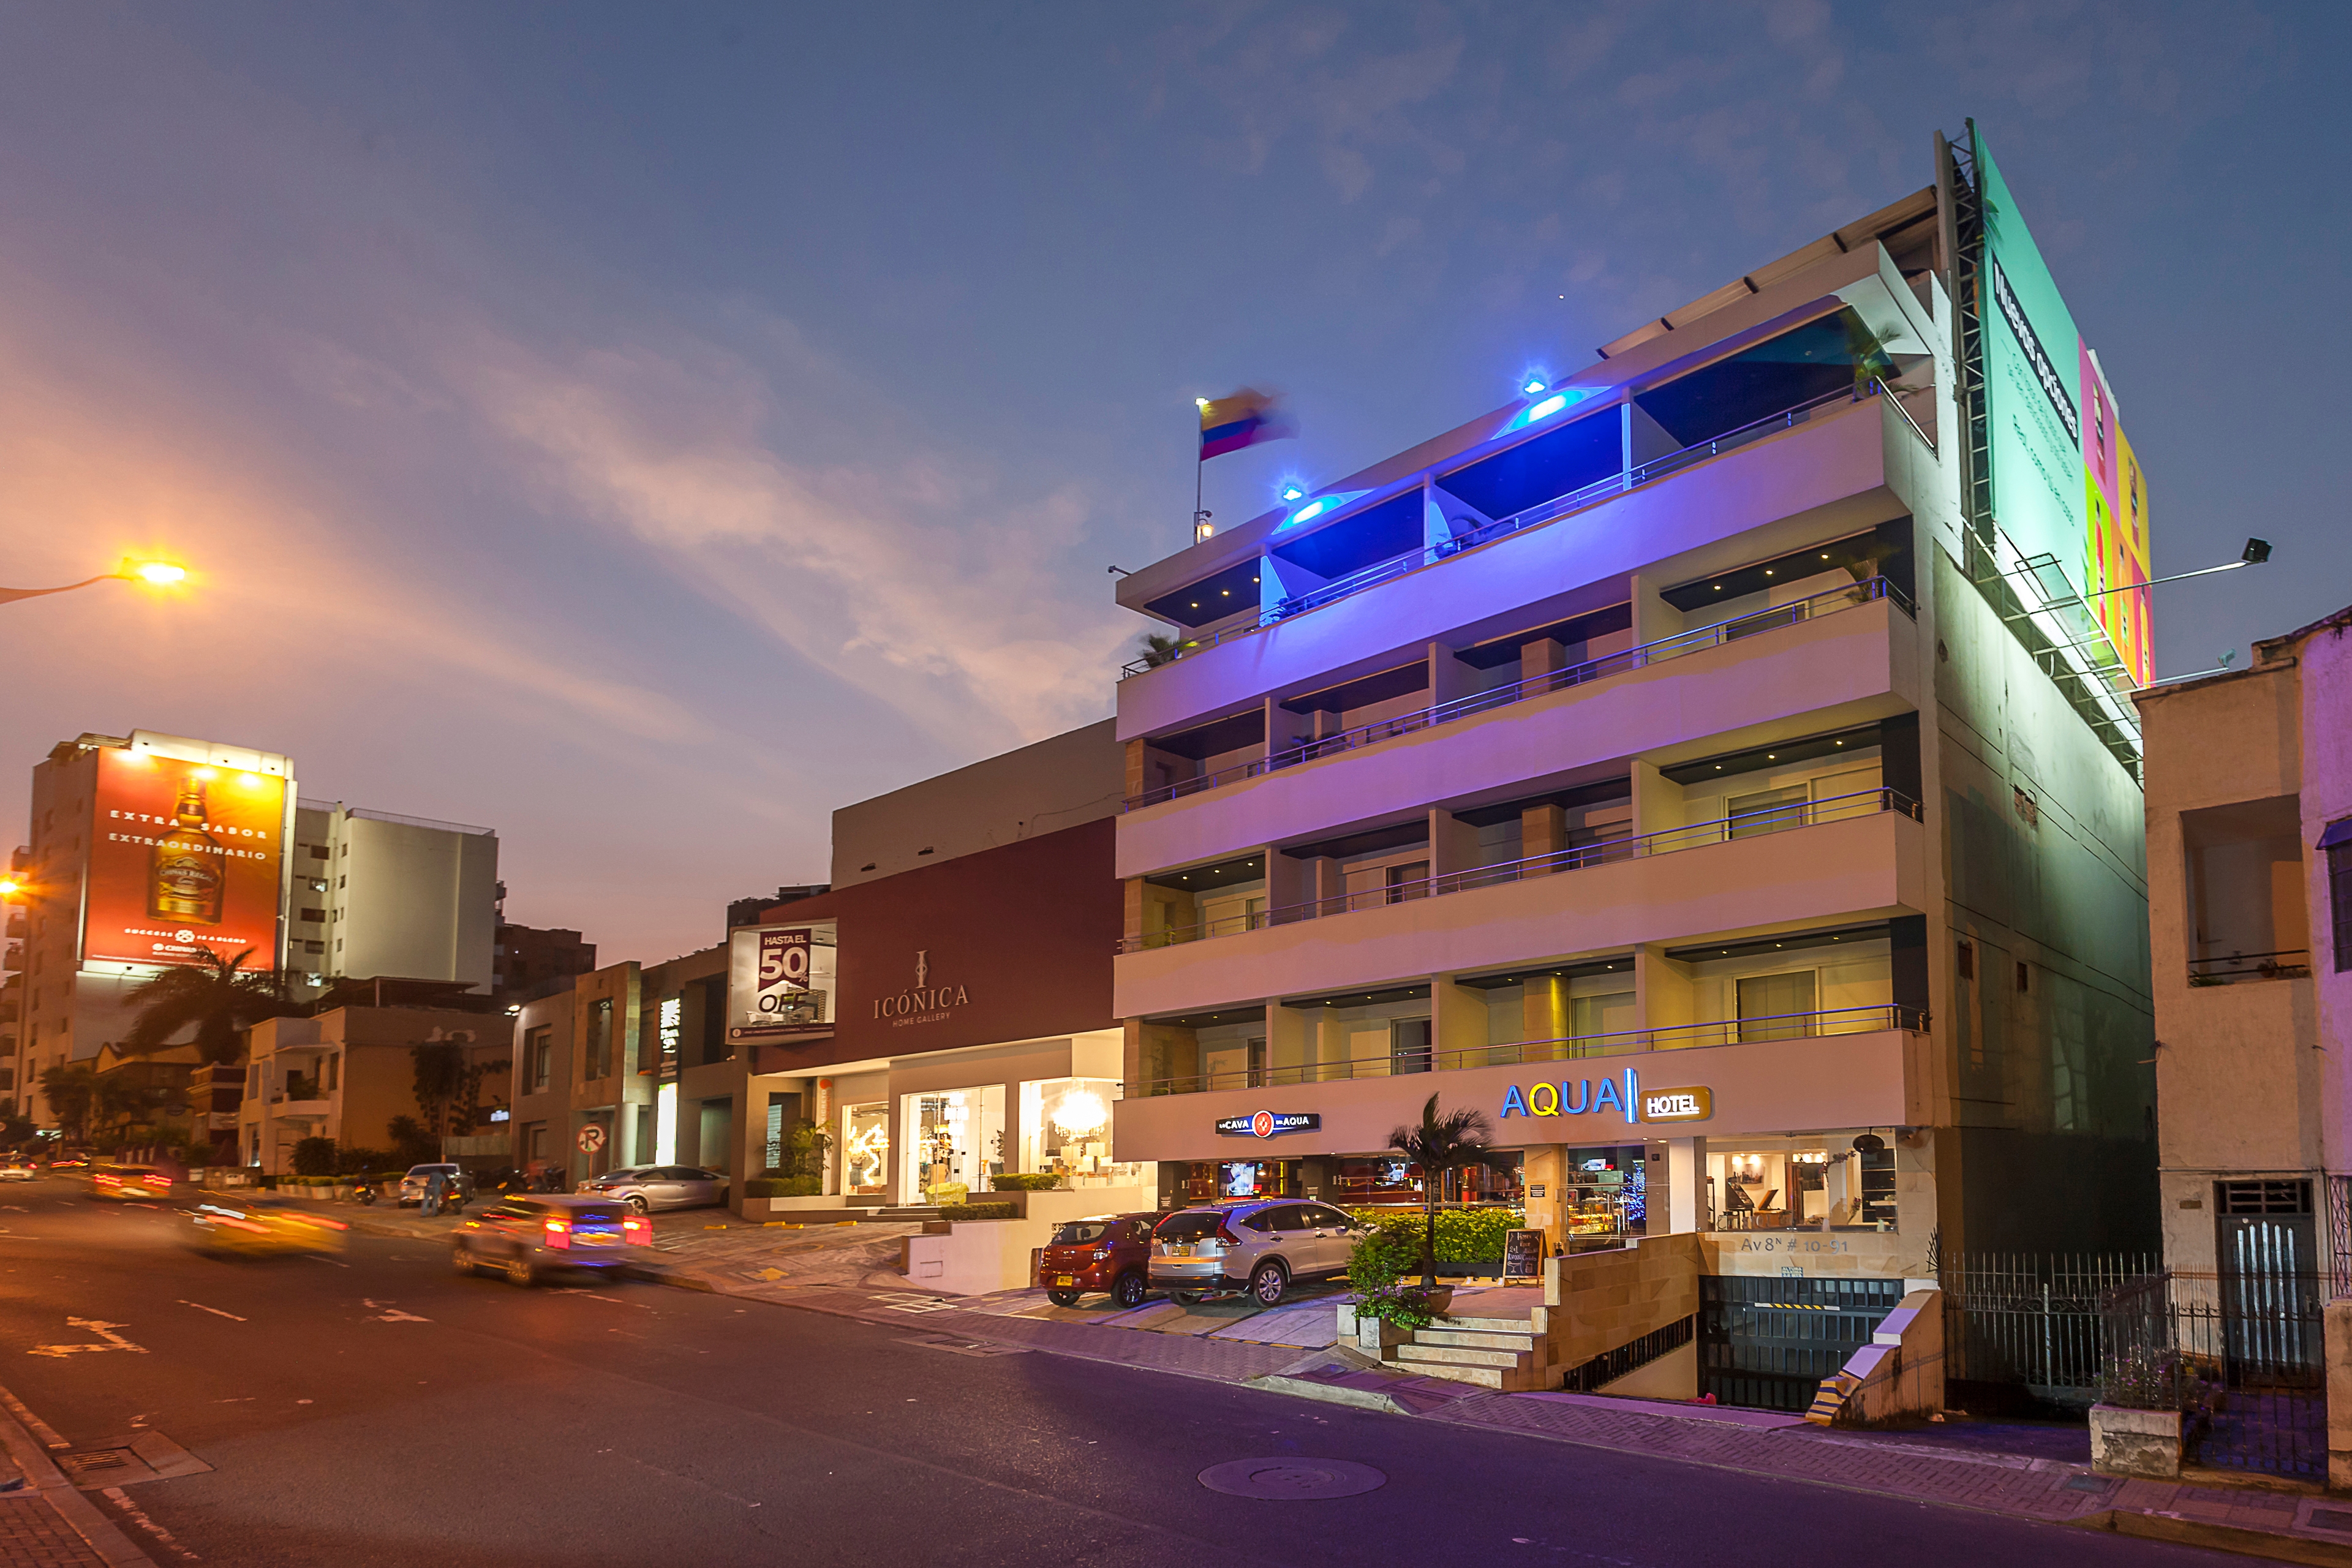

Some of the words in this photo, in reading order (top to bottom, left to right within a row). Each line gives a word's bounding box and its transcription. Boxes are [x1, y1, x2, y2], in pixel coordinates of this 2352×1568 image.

[2036, 352, 2078, 438] opciones
[110, 810, 180, 827] EXTRA
[200, 823, 267, 839] SABOR
[108, 833, 266, 860] EXTRAORDINARIO
[764, 935, 794, 946] HASTA
[794, 935, 807, 944] EL
[758, 992, 809, 1013] OFF
[873, 984, 969, 1019] ICÓNICA
[892, 1017, 914, 1028] HOME
[916, 1012, 951, 1023] GALLERY
[1500, 1078, 1623, 1118] AQUA
[1646, 1095, 1700, 1114] HOTEL
[1225, 1120, 1250, 1129] CAVA
[1283, 1116, 1310, 1126] AQUA
[1741, 1238, 1762, 1251] Av
[1787, 1238, 1797, 1251] #
[1804, 1239, 1848, 1254] 10-91
